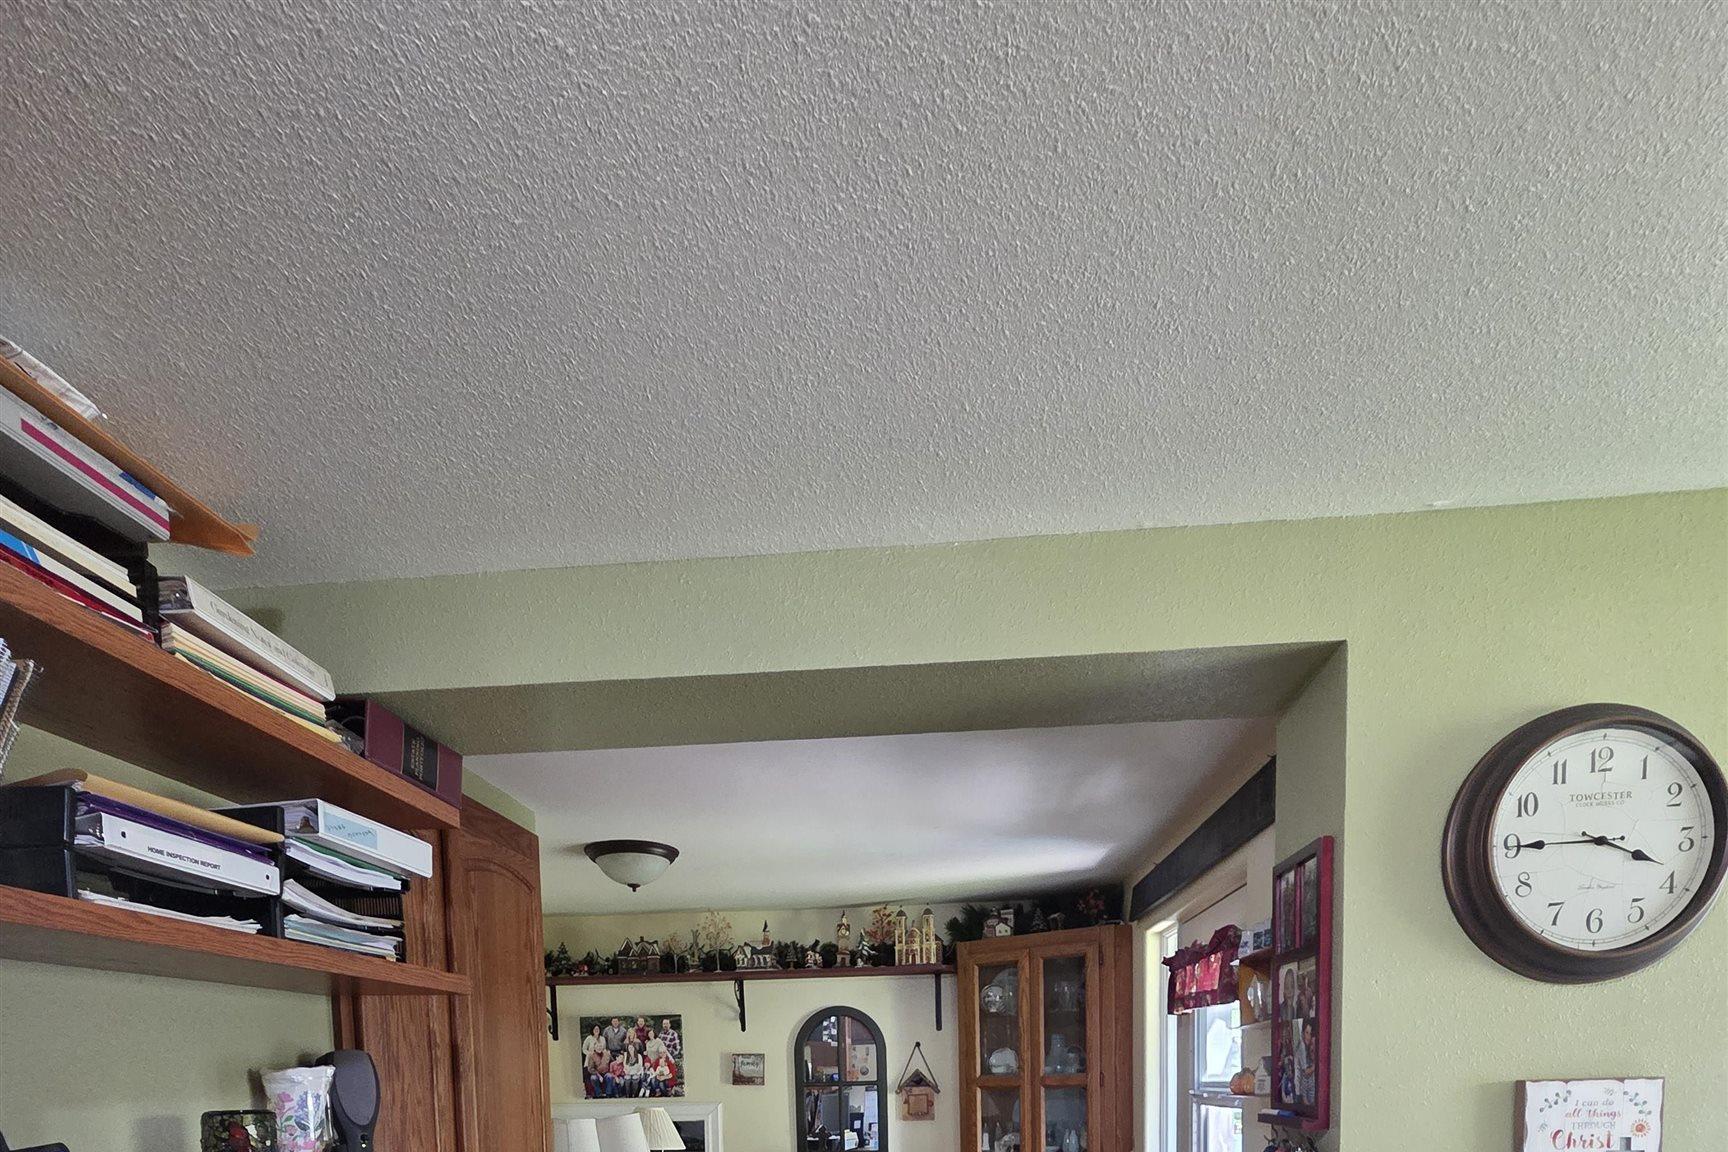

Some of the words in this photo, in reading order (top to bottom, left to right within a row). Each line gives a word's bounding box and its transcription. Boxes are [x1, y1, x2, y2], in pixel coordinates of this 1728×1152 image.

[1552, 758, 1567, 785] 11
[1590, 746, 1614, 773] 12
[1641, 755, 1648, 779] 1
[1516, 792, 1539, 817] 10
[1569, 790, 1633, 802] TOWCESTER
[1666, 782, 1683, 807] 2
[1503, 833, 1521, 859] 9
[1678, 826, 1695, 852] 3
[147, 846, 165, 856] HOME
[166, 851, 200, 865] INSPECTION
[200, 860, 221, 870] REPORT
[1515, 872, 1532, 897] 8
[1659, 870, 1677, 894] 4
[1547, 902, 1564, 926] 7
[1585, 908, 1603, 934] 6
[1627, 897, 1645, 923] 5
[1565, 1107, 1581, 1118] all
[1588, 1108, 1621, 1120] things
[1571, 1121, 1616, 1130] THROUGH
[1550, 1129, 1613, 1150] Christ
